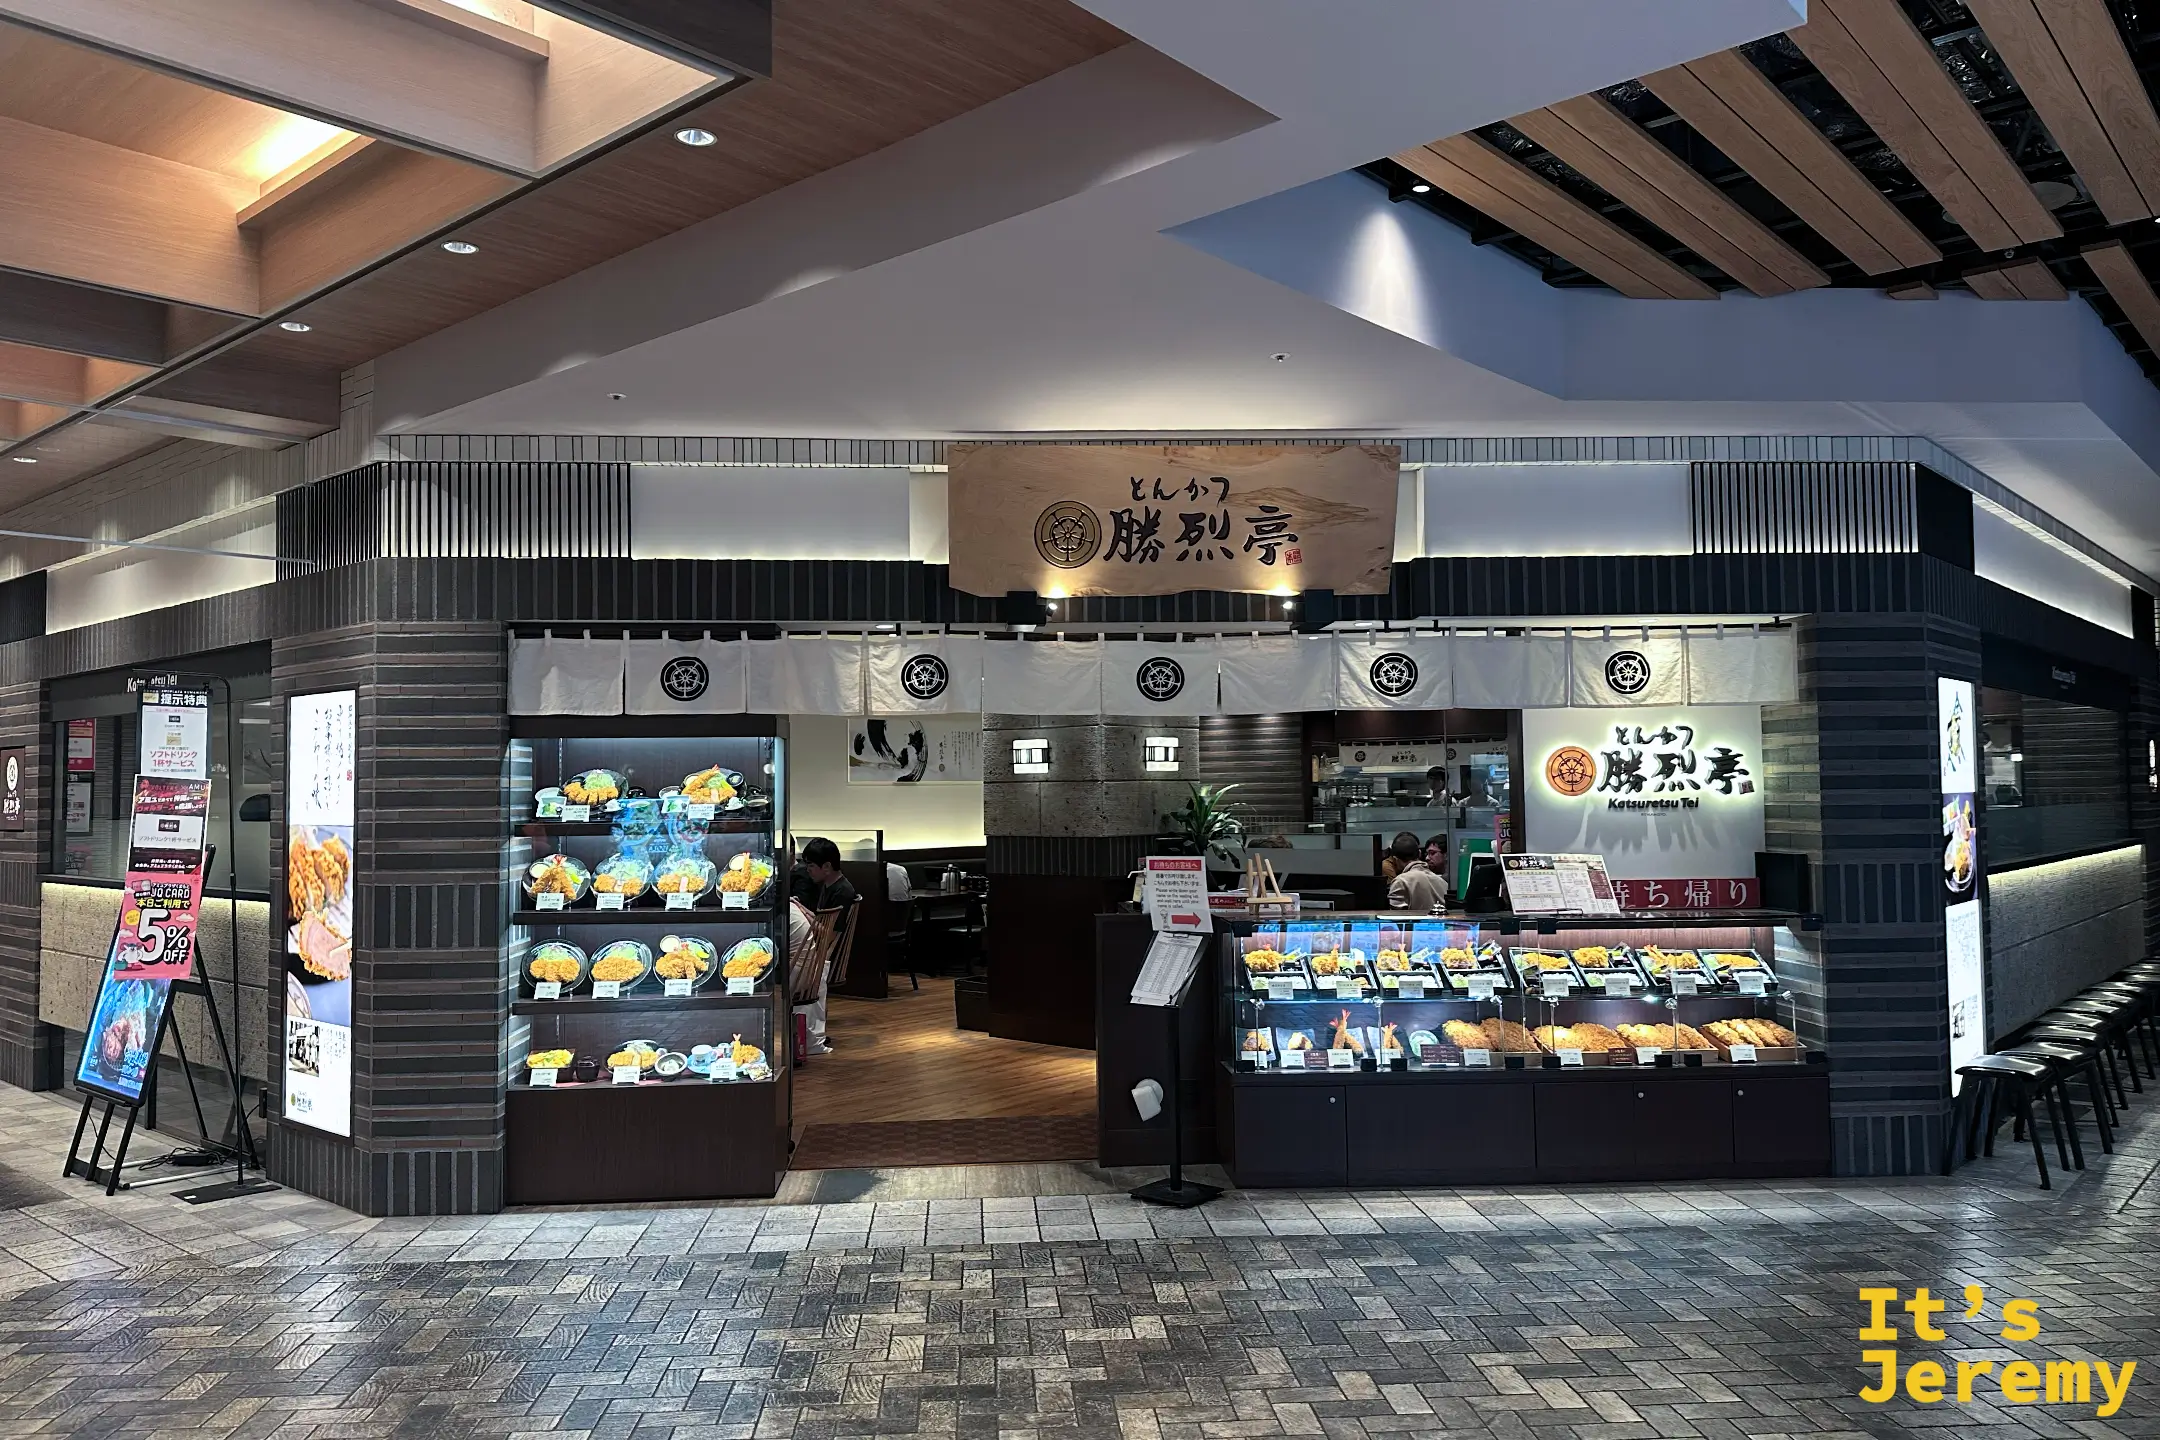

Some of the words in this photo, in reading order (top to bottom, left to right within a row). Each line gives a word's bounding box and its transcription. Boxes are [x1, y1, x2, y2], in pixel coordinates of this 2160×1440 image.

[1130, 476, 1229, 506] とんかつ
[1103, 505, 1299, 565] 勝烈亭
[160, 692, 208, 706] 提示特典
[1615, 726, 1693, 750] とんかつ
[150, 751, 198, 759] ソフトドリンク
[1597, 748, 1750, 794] 勝烈亭
[1608, 798, 1679, 809] Katsuretsu
[1680, 797, 1699, 809] Tei
[165, 888, 190, 898] CARD
[136, 898, 191, 908] 本日ご利用で
[163, 949, 187, 961] OFF
